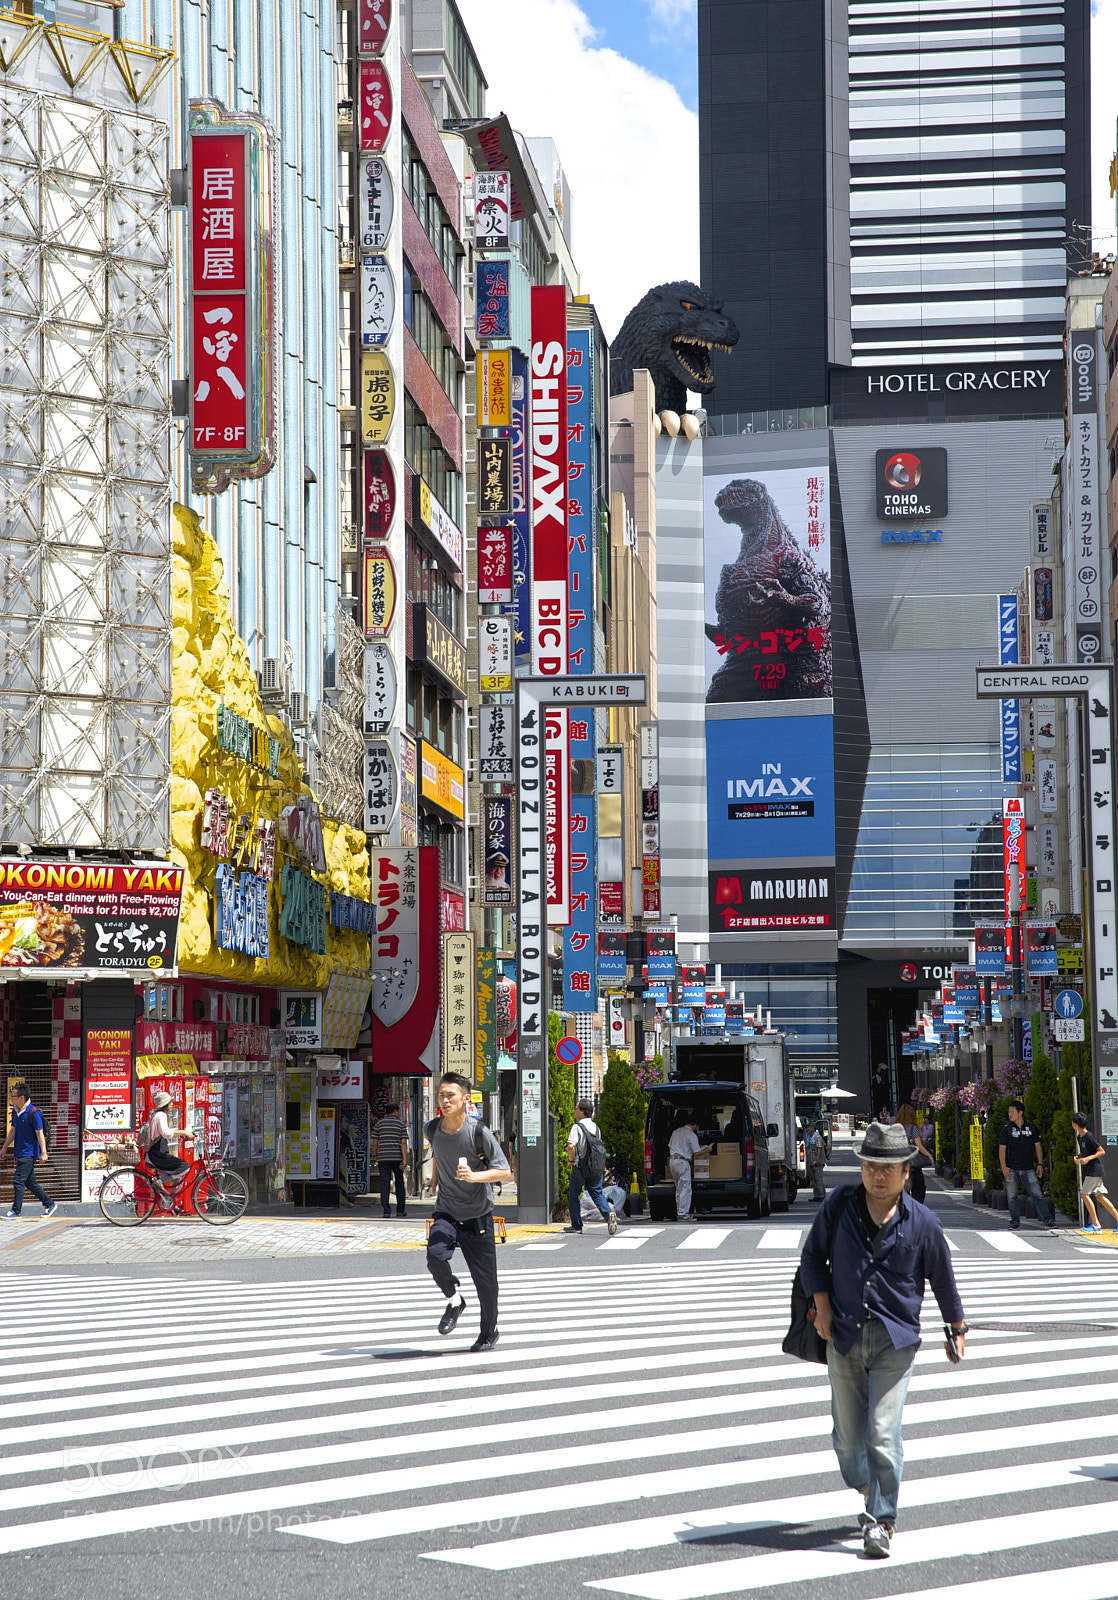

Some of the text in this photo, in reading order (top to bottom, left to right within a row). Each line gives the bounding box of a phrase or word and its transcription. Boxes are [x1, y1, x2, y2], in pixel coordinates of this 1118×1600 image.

[363, 42, 379, 50] 8F
[363, 81, 389, 129] つぼ八
[364, 140, 382, 148] 7F
[477, 175, 496, 185] 海鮮
[477, 185, 506, 194] 居酒屋
[367, 176, 382, 224] ヤキトリ
[201, 167, 235, 281] 居酒屋
[363, 233, 385, 246] 6F
[485, 237, 499, 247] 8F
[366, 276, 385, 329] うさぎや
[477, 273, 508, 336] 海の家
[368, 335, 382, 343] 5F
[193, 306, 247, 403] つぼ八
[1073, 343, 1095, 403] Booth
[491, 359, 507, 416] 鳥貴族
[867, 369, 1051, 394] HOTEL GRACERY
[366, 376, 390, 422] 虎の子
[365, 430, 382, 439] 4F
[531, 340, 567, 528] SHIDAX
[483, 442, 504, 502] 山内農場
[884, 494, 919, 506] TOHO
[489, 503, 500, 511] 5F
[884, 506, 932, 516] CINEMAS
[880, 529, 944, 544] IMAX
[1037, 513, 1049, 553] 東京ビル
[1082, 570, 1095, 582] 8F
[371, 560, 386, 626] お好み焼き
[487, 590, 503, 602] 4F
[1083, 603, 1095, 614] 5F
[537, 598, 561, 649] BIC
[752, 663, 787, 682] 7.29
[488, 676, 505, 688] 3F
[983, 675, 1090, 688] CENTRAL ROAD
[369, 722, 385, 732] 1F
[487, 706, 508, 758] お好み焼
[481, 759, 512, 773] 大阪家
[762, 762, 782, 775] IN
[367, 757, 388, 809] かっぱ
[727, 776, 814, 799] IMAX
[369, 814, 386, 825] B1
[488, 802, 506, 850] 海の家
[520, 734, 541, 1006] GODZILLA ROAD
[1090, 748, 1114, 983] ゴジラロード
[122, 868, 183, 891] YAKI
[402, 850, 416, 909] 大衆酒場
[750, 878, 829, 901] MARUHAN
[65, 891, 96, 903] dinner
[97, 892, 118, 904] with
[119, 894, 180, 908] Free-Flowing
[570, 814, 592, 992] カラオケ館
[63, 905, 178, 917] Drinks for 2 hours ¥2,700
[377, 857, 400, 958] トラノコ
[600, 914, 622, 924] Cafe
[98, 956, 161, 969] TORADYU 2F
[600, 962, 624, 970] IMAX
[649, 962, 674, 970] IMAX
[978, 957, 1003, 966] IMAX
[1031, 956, 1056, 965] IMAX
[922, 965, 952, 979] TOH
[645, 991, 665, 999] IMAX
[684, 991, 705, 999] IMAX
[956, 994, 978, 1002] IMAX
[944, 1009, 964, 1017] IMAX
[87, 1030, 131, 1041] OKONOMI
[98, 1040, 122, 1050] YAKI
[451, 1033, 469, 1053] 集
[321, 1076, 361, 1087] トラノコ
